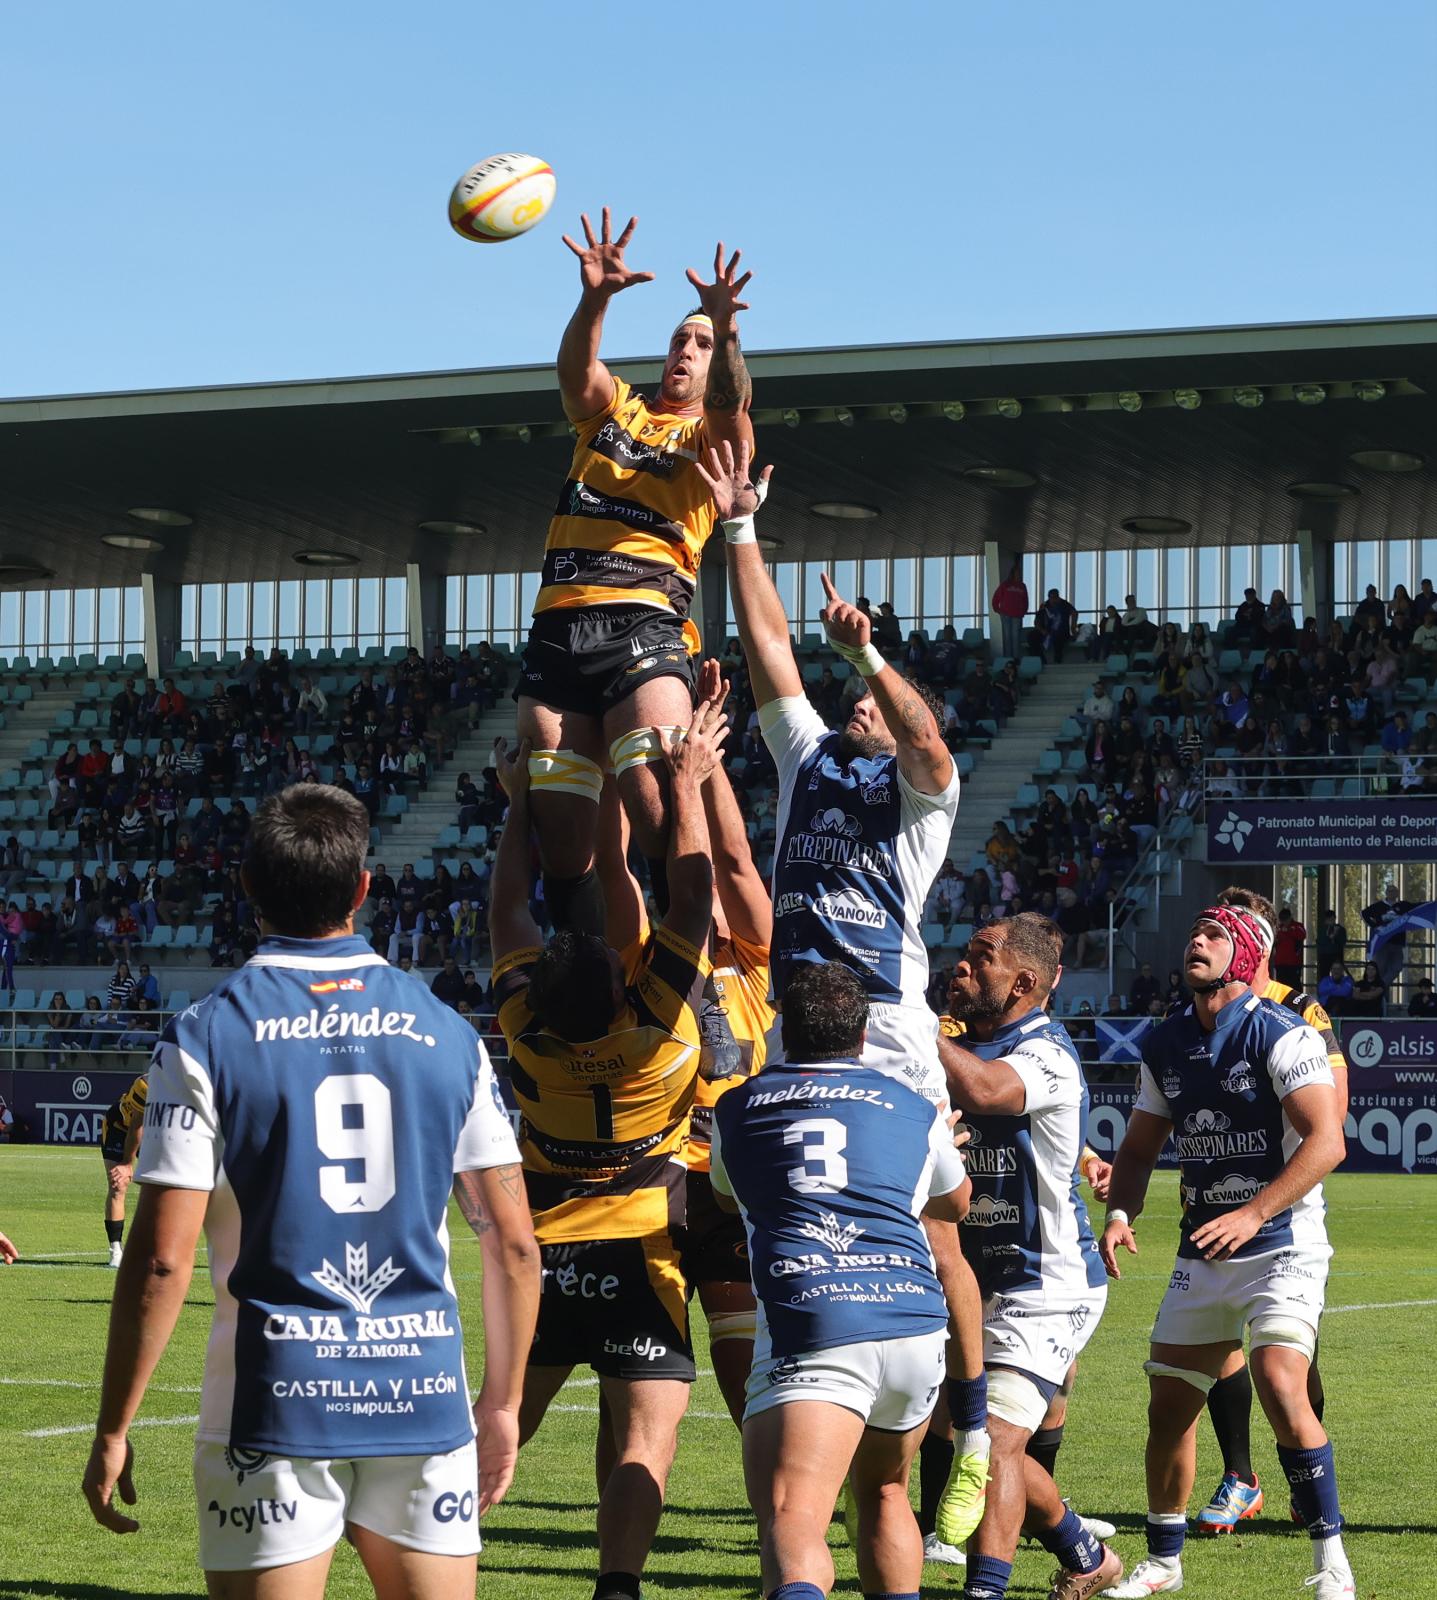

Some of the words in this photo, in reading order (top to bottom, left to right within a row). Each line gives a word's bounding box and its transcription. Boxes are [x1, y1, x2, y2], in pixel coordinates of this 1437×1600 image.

[1257, 816, 1315, 829] Patronato
[1318, 815, 1376, 829] Municipal
[1381, 816, 1397, 827] de
[1276, 835, 1363, 850] Ayuntamiento
[1366, 835, 1381, 846] de
[1385, 834, 1437, 847] Palencia
[255, 1004, 435, 1047] meléndez.
[320, 1046, 366, 1055] PATATAS
[1388, 1035, 1435, 1056] alsis
[745, 1080, 895, 1110] meléndez.
[1221, 1077, 1256, 1091] VRAC
[588, 1083, 614, 1140] 1
[314, 1073, 396, 1214] 9
[783, 1118, 848, 1194] 3
[769, 1254, 832, 1278] CAJA
[790, 1282, 865, 1305] CASTILLA
[869, 1283, 880, 1294] Y
[886, 1281, 926, 1295] LEÓN
[263, 1313, 347, 1342] CAJA
[356, 1310, 455, 1342] RURAL
[315, 1344, 342, 1359] DE
[346, 1343, 422, 1358] ZAMORA
[272, 1379, 378, 1398] CASTILLA
[388, 1379, 403, 1399] Y
[412, 1371, 457, 1396] LEÓN
[1081, 1572, 1103, 1596] asics
